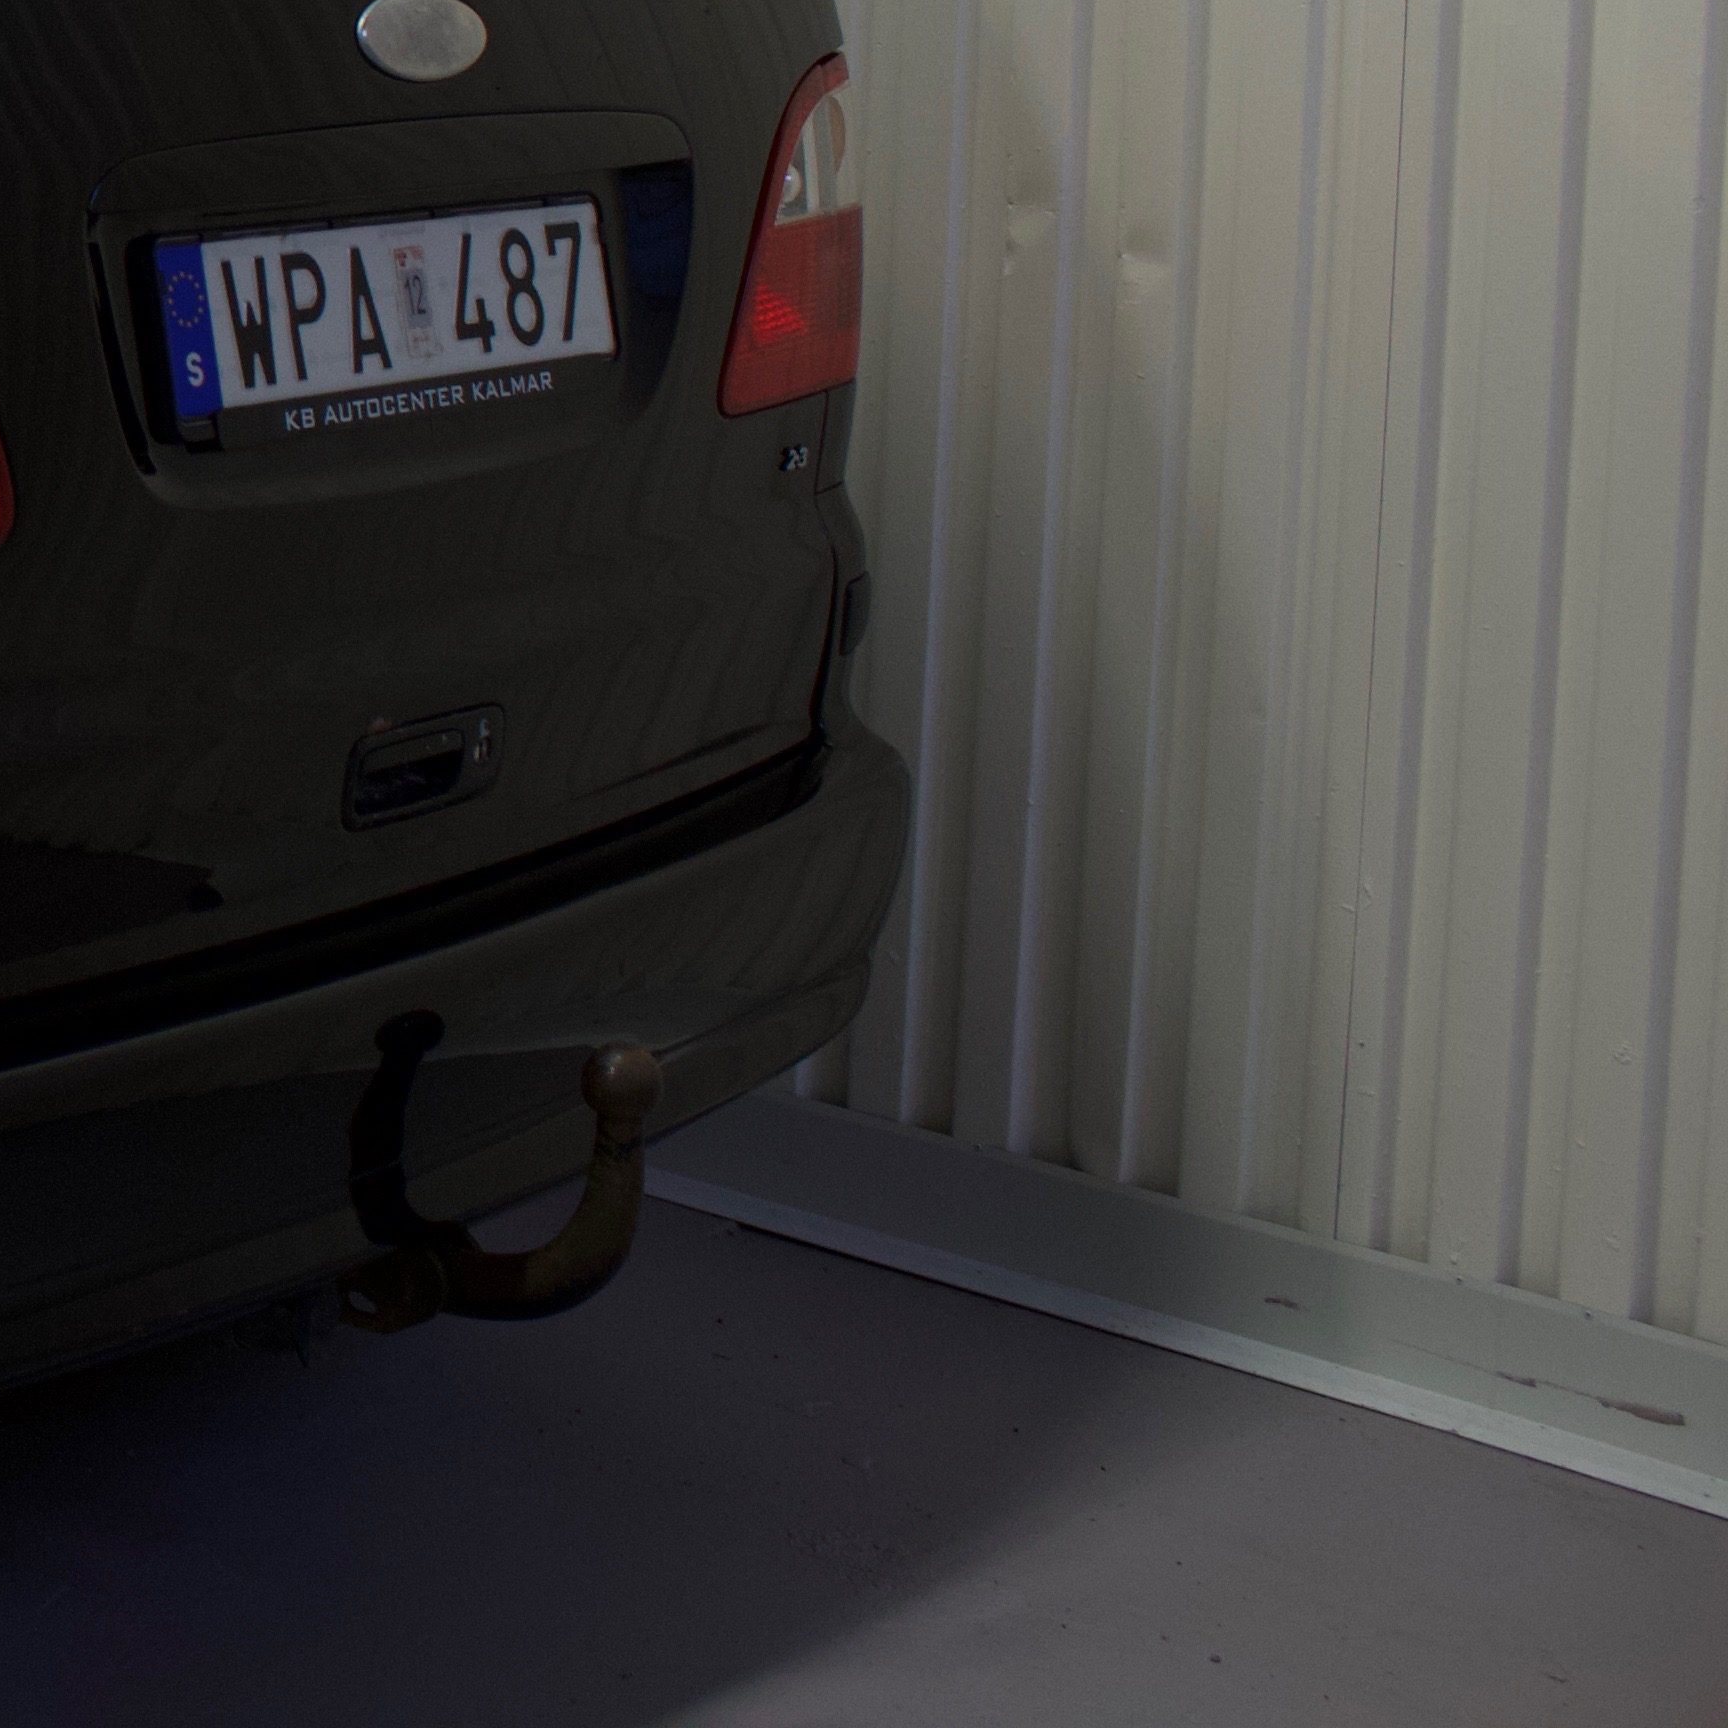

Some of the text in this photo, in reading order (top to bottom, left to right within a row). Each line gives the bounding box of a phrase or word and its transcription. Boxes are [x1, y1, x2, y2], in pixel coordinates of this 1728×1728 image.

[221, 222, 580, 388] WPA 487
[186, 352, 205, 387] S
[284, 371, 553, 432] KB AUTOCENTER KALMAR
